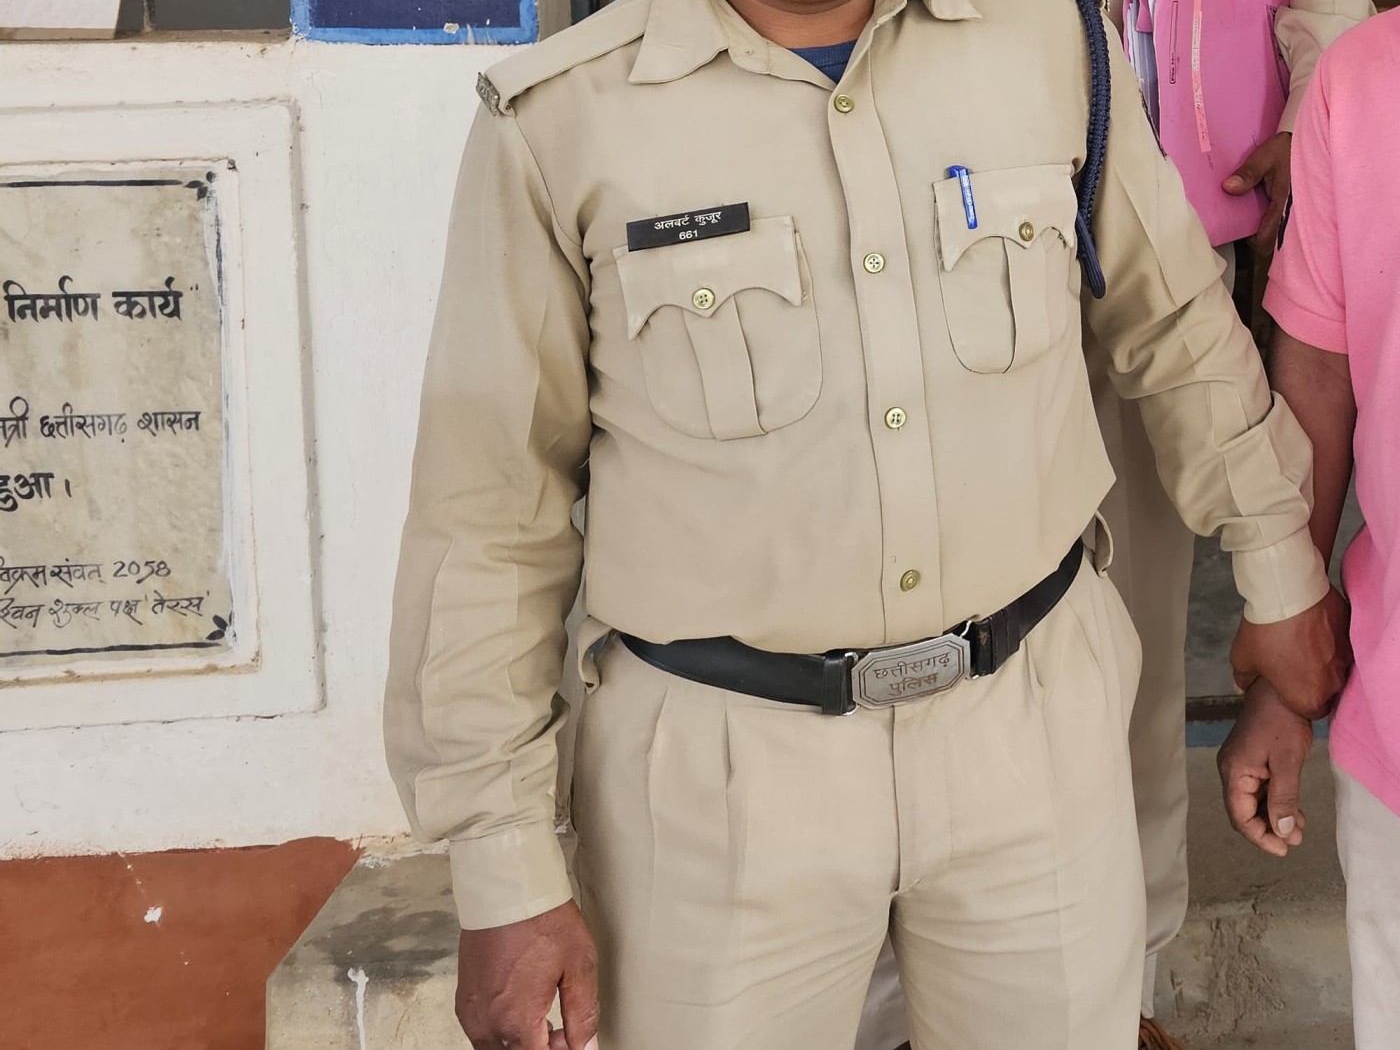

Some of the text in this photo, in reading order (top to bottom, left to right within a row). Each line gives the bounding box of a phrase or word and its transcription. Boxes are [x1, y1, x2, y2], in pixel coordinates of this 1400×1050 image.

[693, 211, 722, 226] कुजूर
[679, 229, 698, 240] 661
[2, 275, 101, 323] निर्माण
[137, 411, 201, 437] शासन
[113, 561, 171, 584] 2058
[873, 651, 951, 679] छत्तीसगढ़
[888, 672, 938, 697] पुलिस
